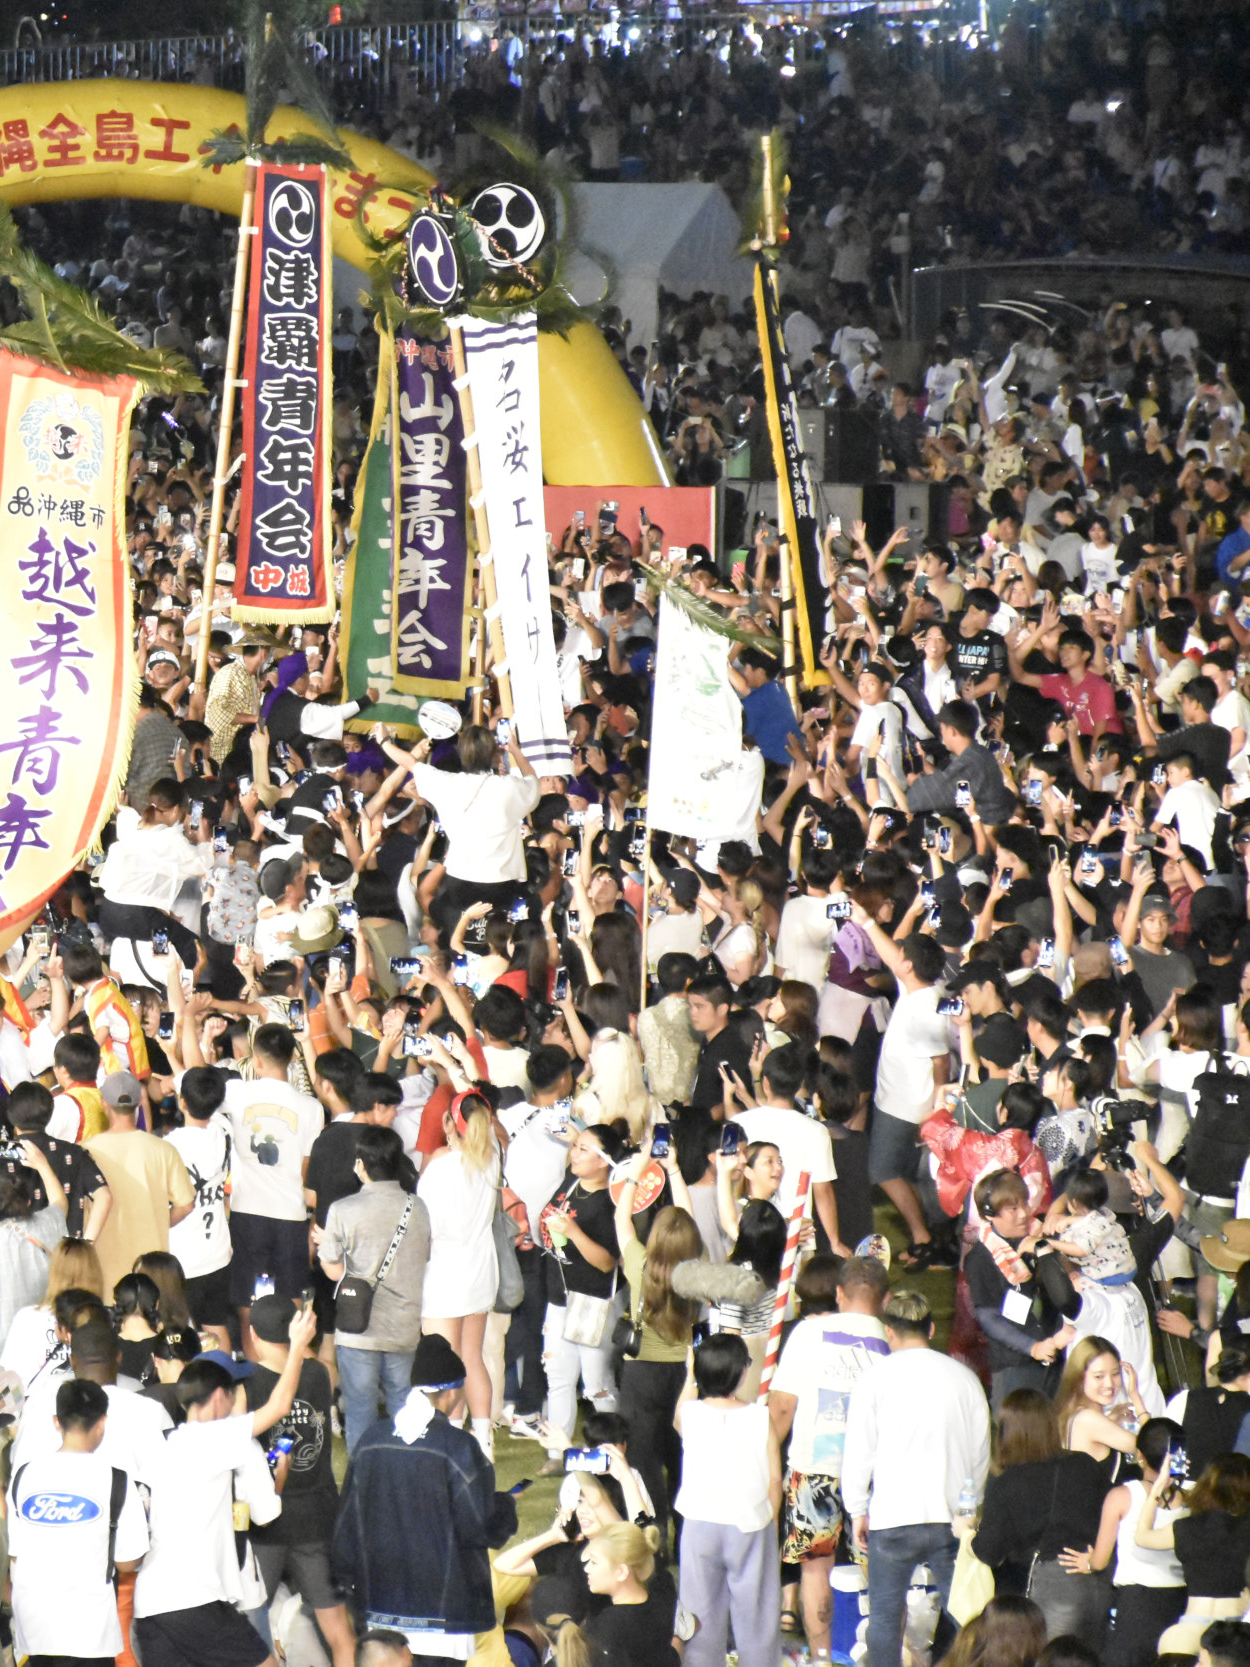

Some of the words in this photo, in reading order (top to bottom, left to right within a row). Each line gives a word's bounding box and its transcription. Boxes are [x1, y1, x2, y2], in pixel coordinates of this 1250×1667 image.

[37, 493, 106, 530] 沖縄市
[397, 372, 456, 669] 山里青年会
[29, 1494, 85, 1521] Ford
